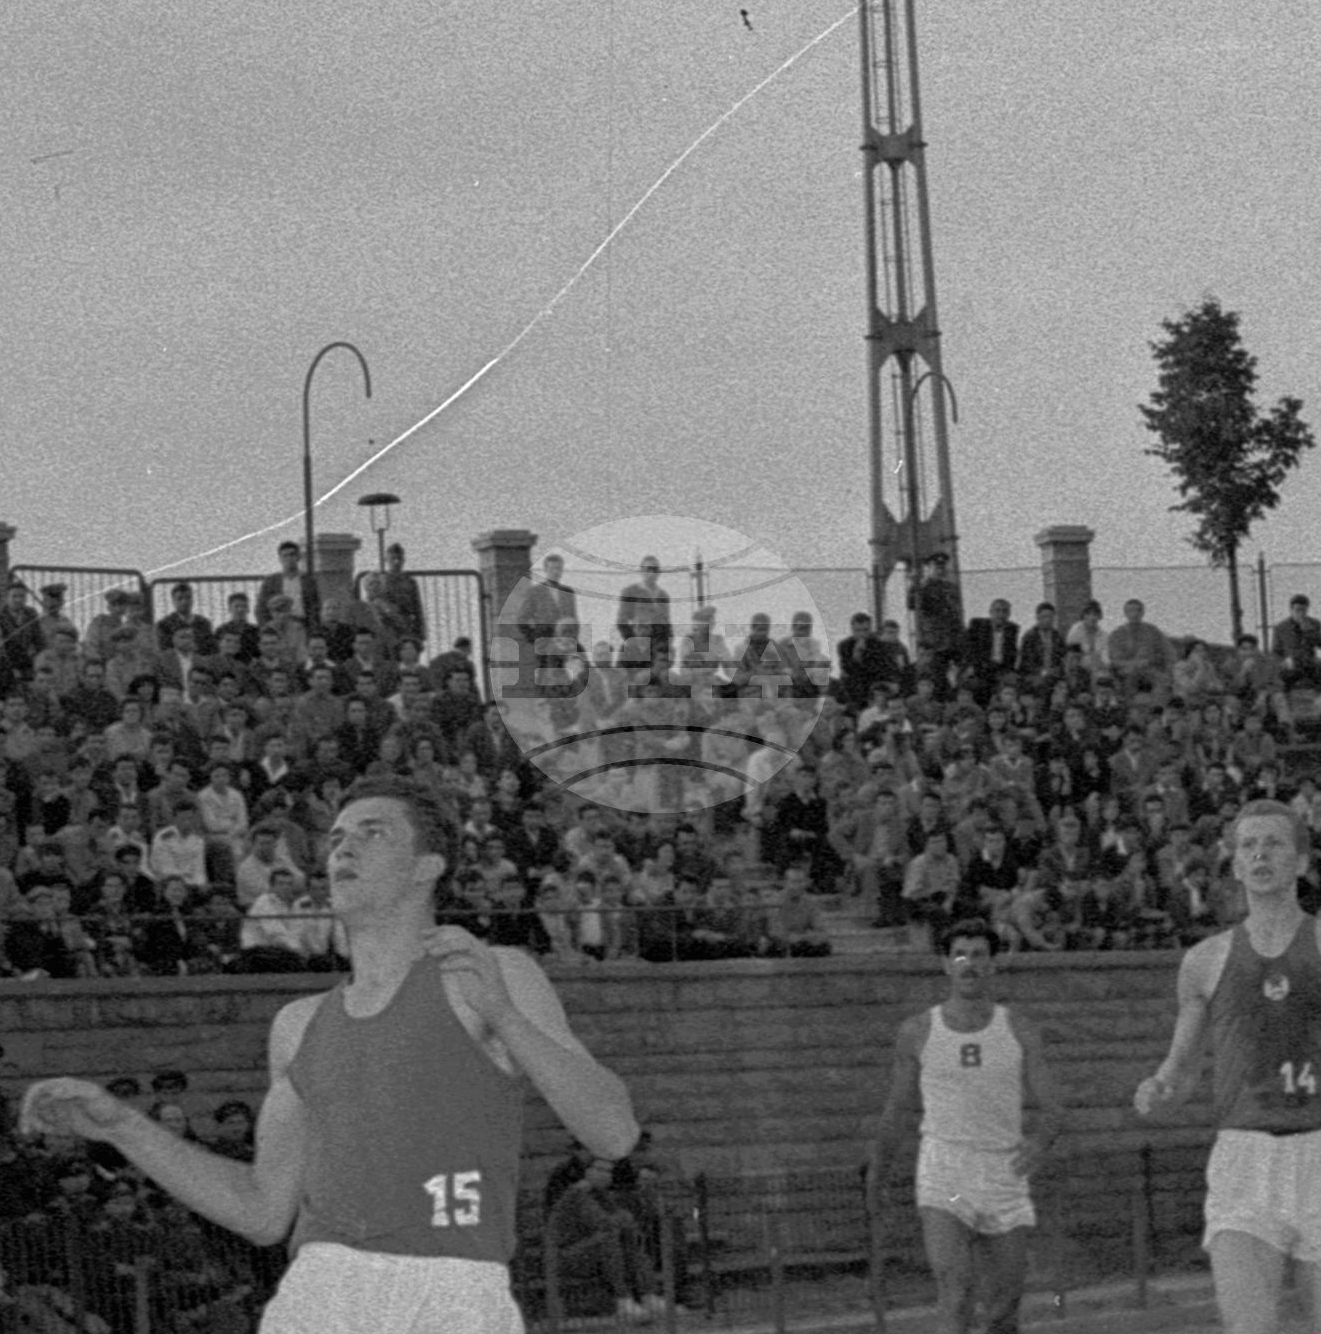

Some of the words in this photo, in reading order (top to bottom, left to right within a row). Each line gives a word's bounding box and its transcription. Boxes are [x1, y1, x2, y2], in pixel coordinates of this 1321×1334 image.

[960, 1043, 982, 1068] 8
[1280, 1061, 1316, 1094] 14
[422, 1170, 481, 1226] 15
